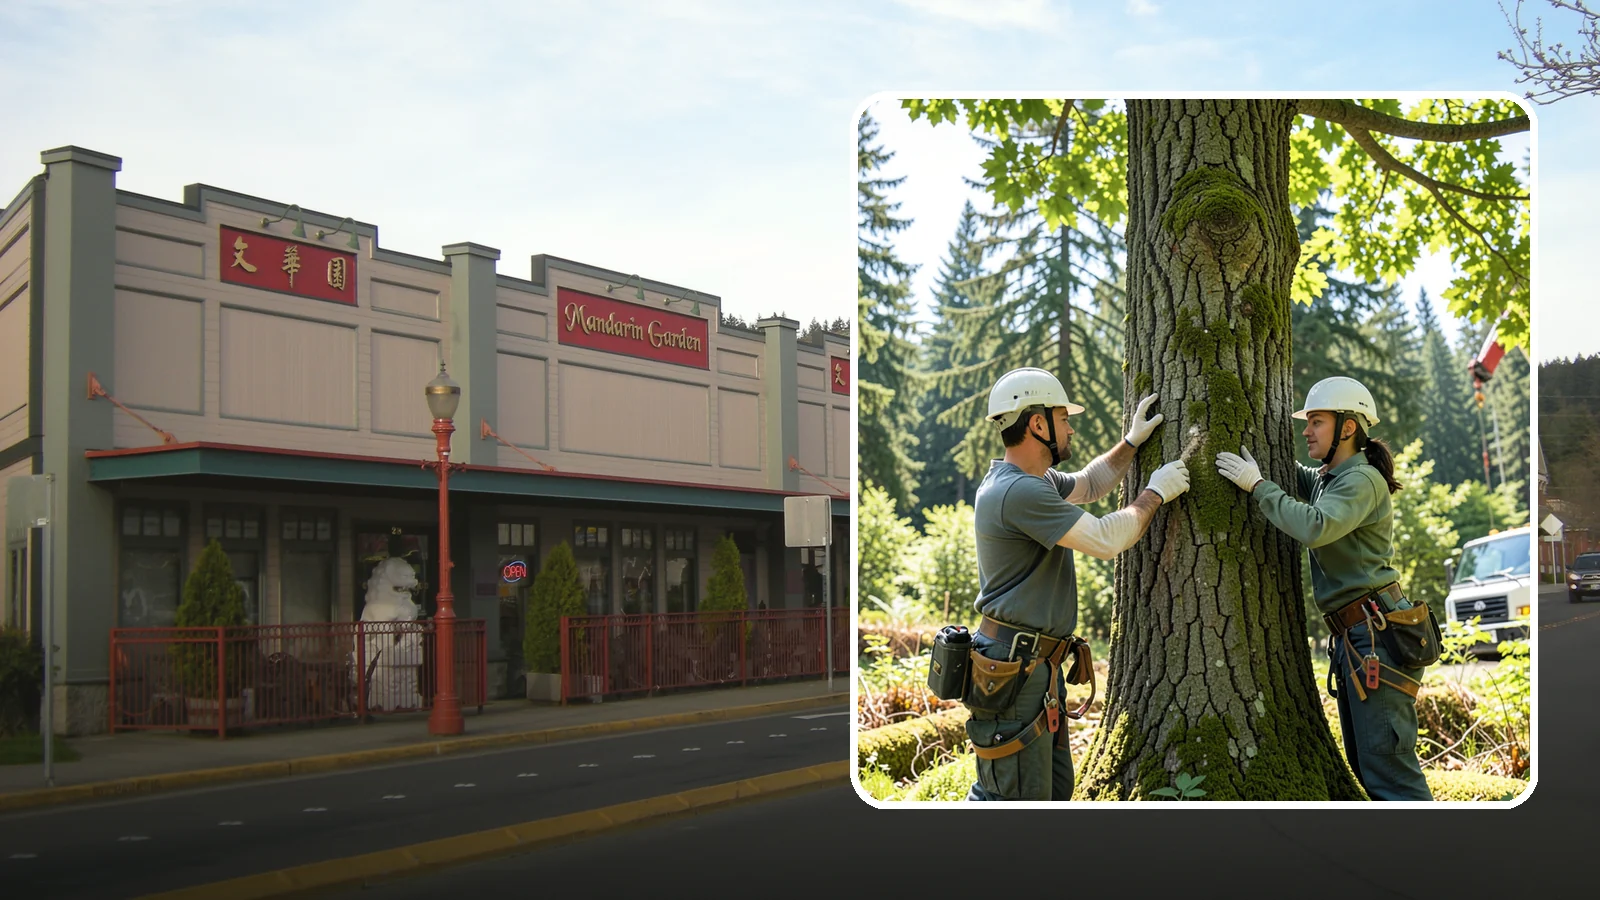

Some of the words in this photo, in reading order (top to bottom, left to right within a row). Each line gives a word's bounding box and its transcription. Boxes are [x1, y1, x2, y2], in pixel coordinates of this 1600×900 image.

[231, 235, 346, 291] 文華園
[564, 302, 644, 341] Mandarin
[648, 320, 701, 352] Garden
[503, 565, 527, 578] OPEN
